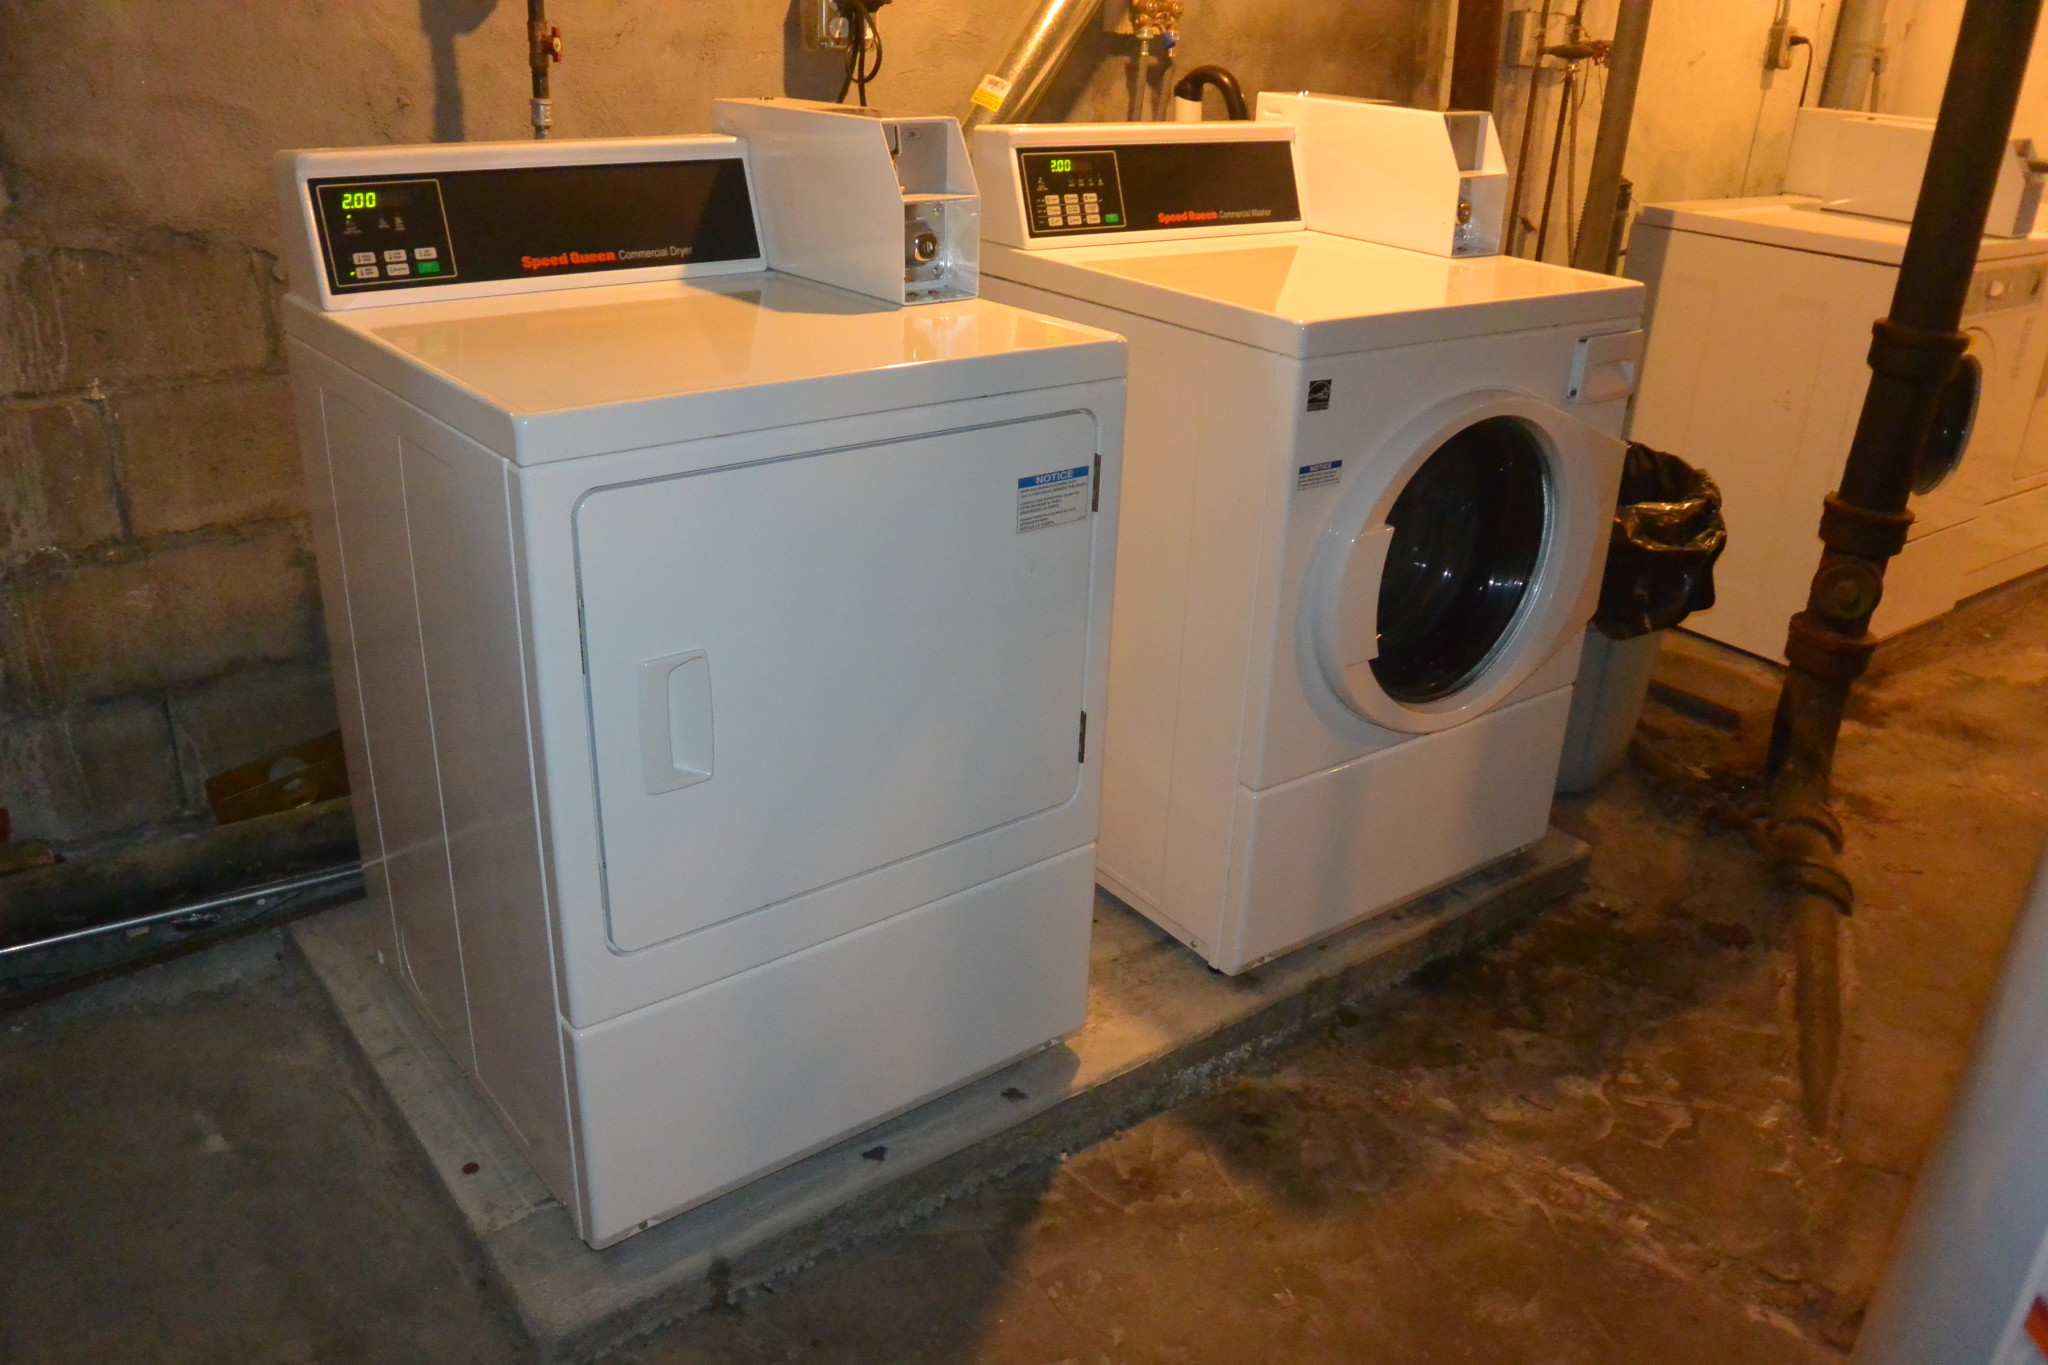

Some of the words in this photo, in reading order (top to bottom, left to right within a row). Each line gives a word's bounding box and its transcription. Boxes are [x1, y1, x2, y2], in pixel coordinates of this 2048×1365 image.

[342, 192, 376, 210] 2.00
[1158, 211, 1188, 225] Speed
[1188, 210, 1218, 220] Queen
[1219, 210, 1251, 219] Commercial
[521, 252, 568, 270] Speed
[569, 250, 617, 264] Queen
[618, 246, 668, 260] Commercial
[669, 245, 692, 259] Dryer
[1035, 469, 1074, 485] NOTICE
